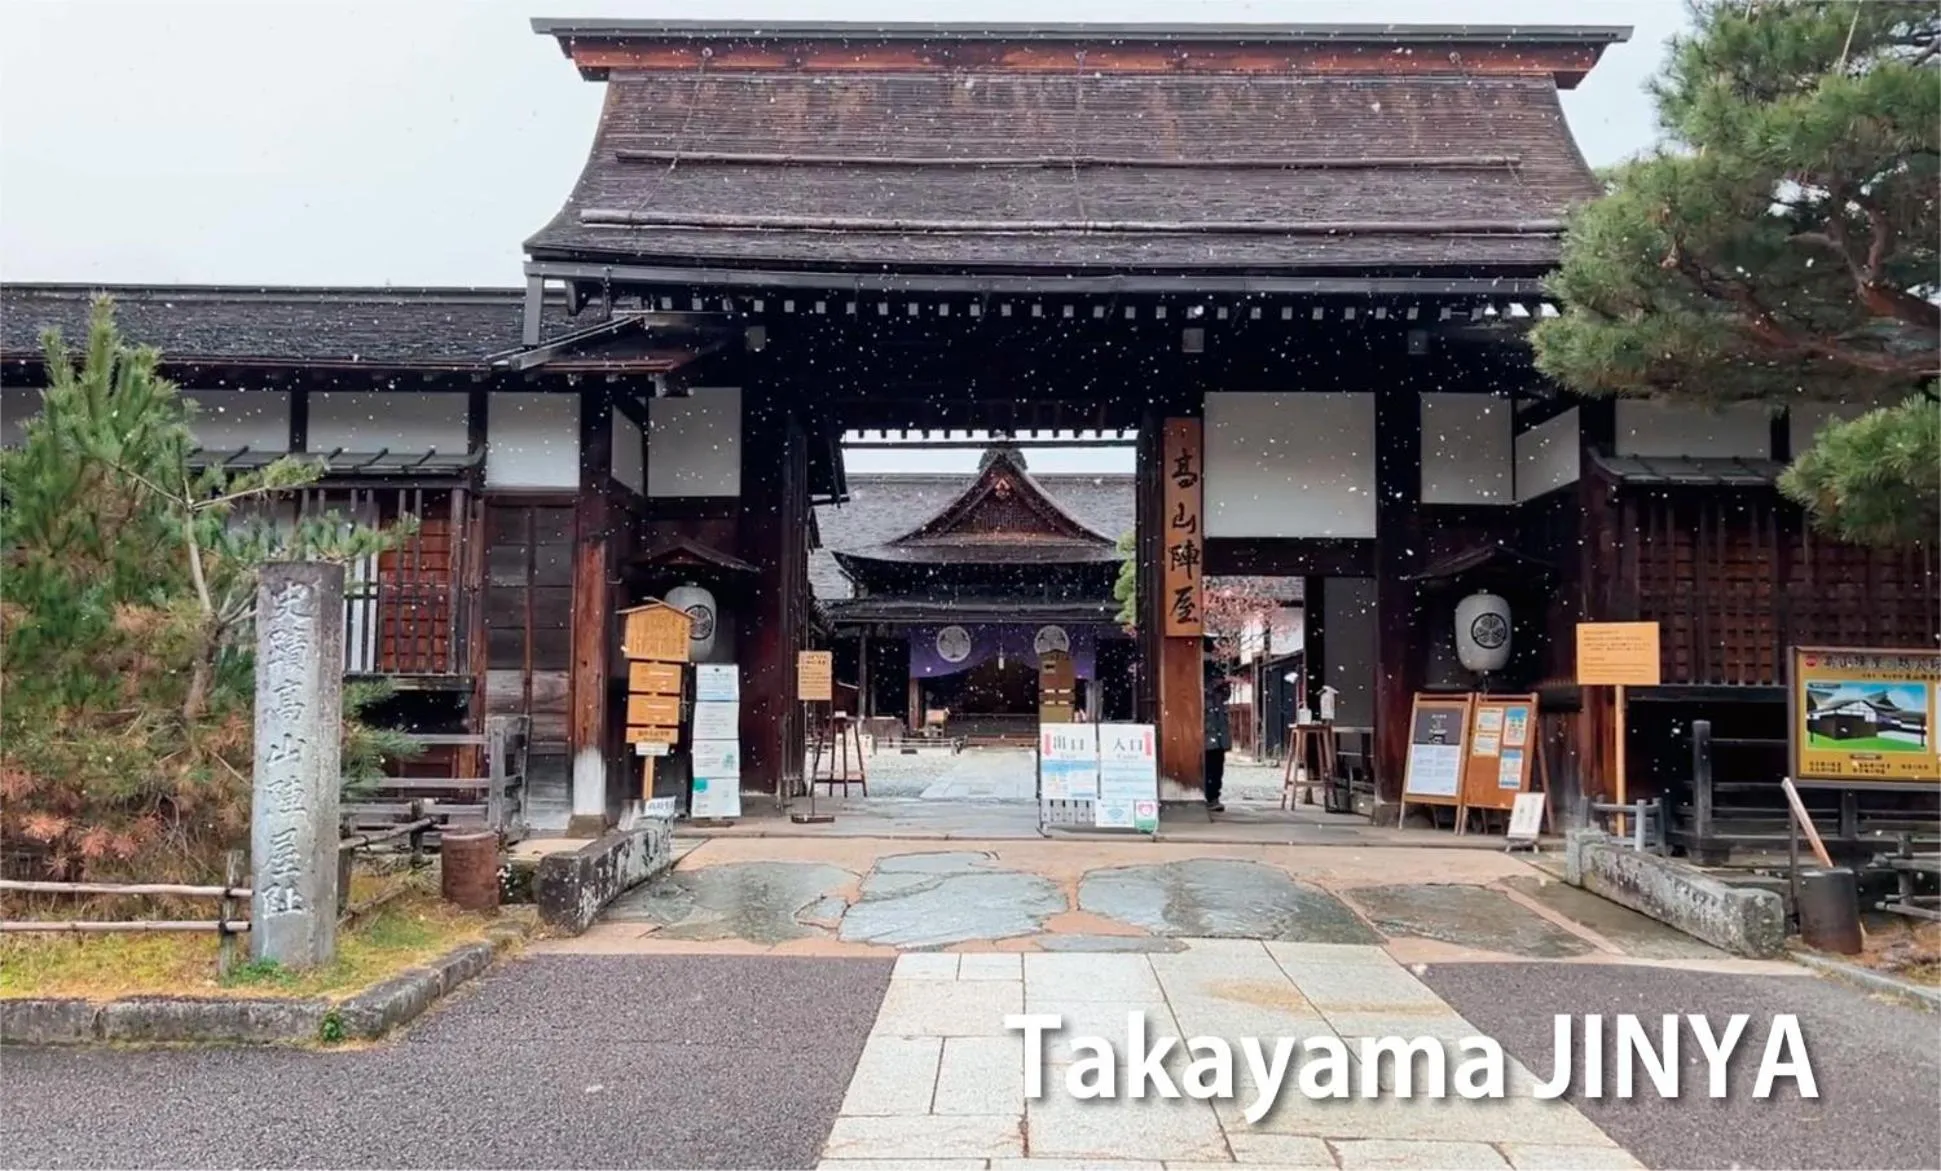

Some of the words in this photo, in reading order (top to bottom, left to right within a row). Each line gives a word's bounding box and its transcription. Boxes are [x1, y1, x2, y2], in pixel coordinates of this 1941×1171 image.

[1168, 447, 1200, 624] 高山陣屋
[1113, 737, 1143, 751] 入口
